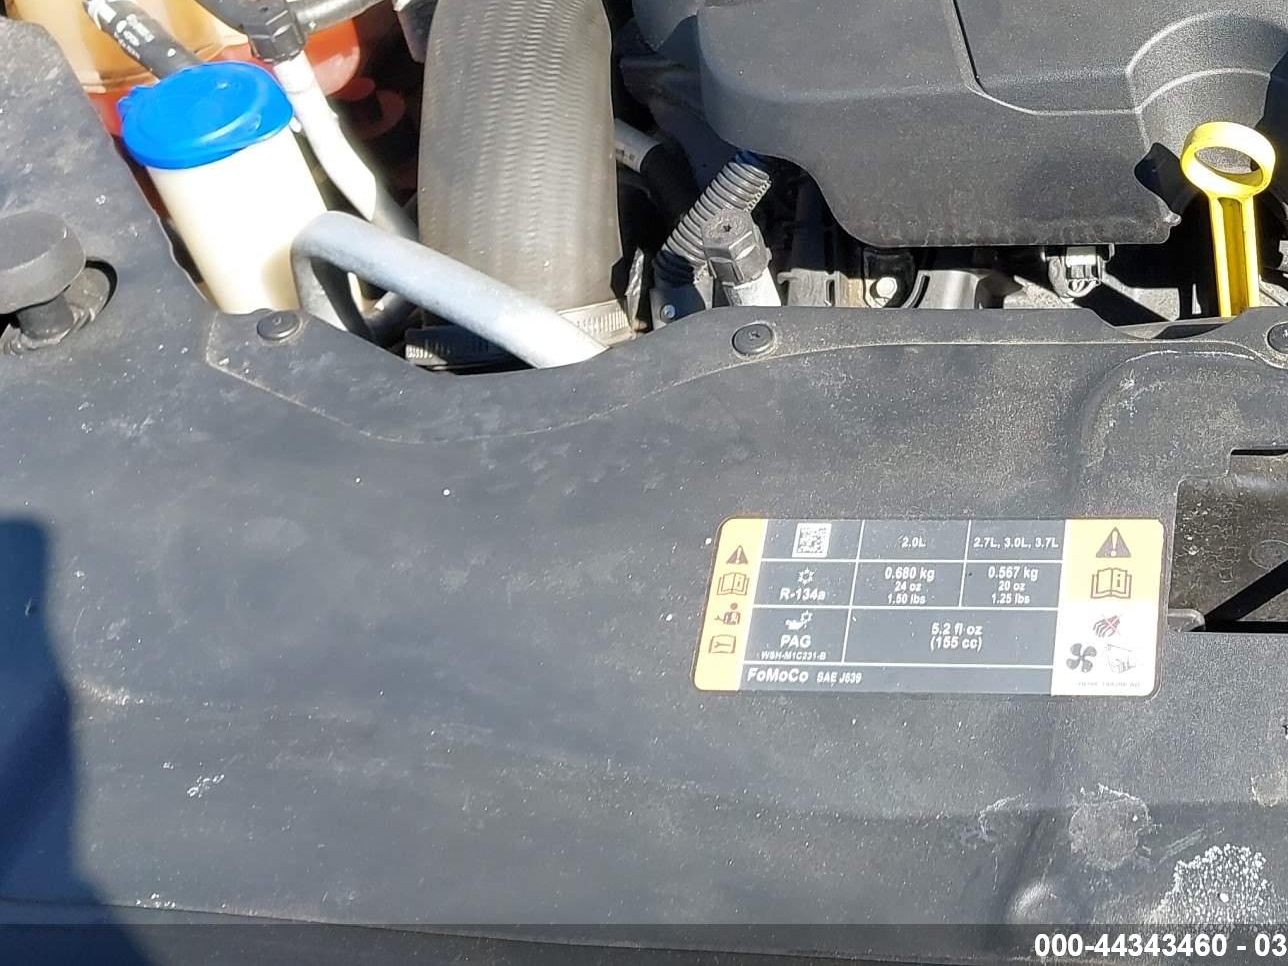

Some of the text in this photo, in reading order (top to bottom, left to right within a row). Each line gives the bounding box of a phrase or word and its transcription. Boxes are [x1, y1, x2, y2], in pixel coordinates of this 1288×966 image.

[901, 537, 926, 548] 2.0L
[973, 537, 1059, 549] 2.7L, 3.0L, 3.7L
[884, 566, 936, 582] 0.680 kg
[988, 566, 1039, 582] 0.567 kg
[894, 581, 922, 592] 24 oz
[998, 581, 1026, 592] 20 oz
[779, 587, 826, 601] R-134a
[887, 593, 927, 604] 1.50 lbs
[991, 593, 1031, 604] 1.25 lbs
[931, 622, 983, 636] 5.2 fl oz
[780, 634, 812, 648] PAG
[930, 636, 983, 652] (155 cc)
[747, 667, 809, 683] FoMoCo
[816, 671, 838, 683] SAE
